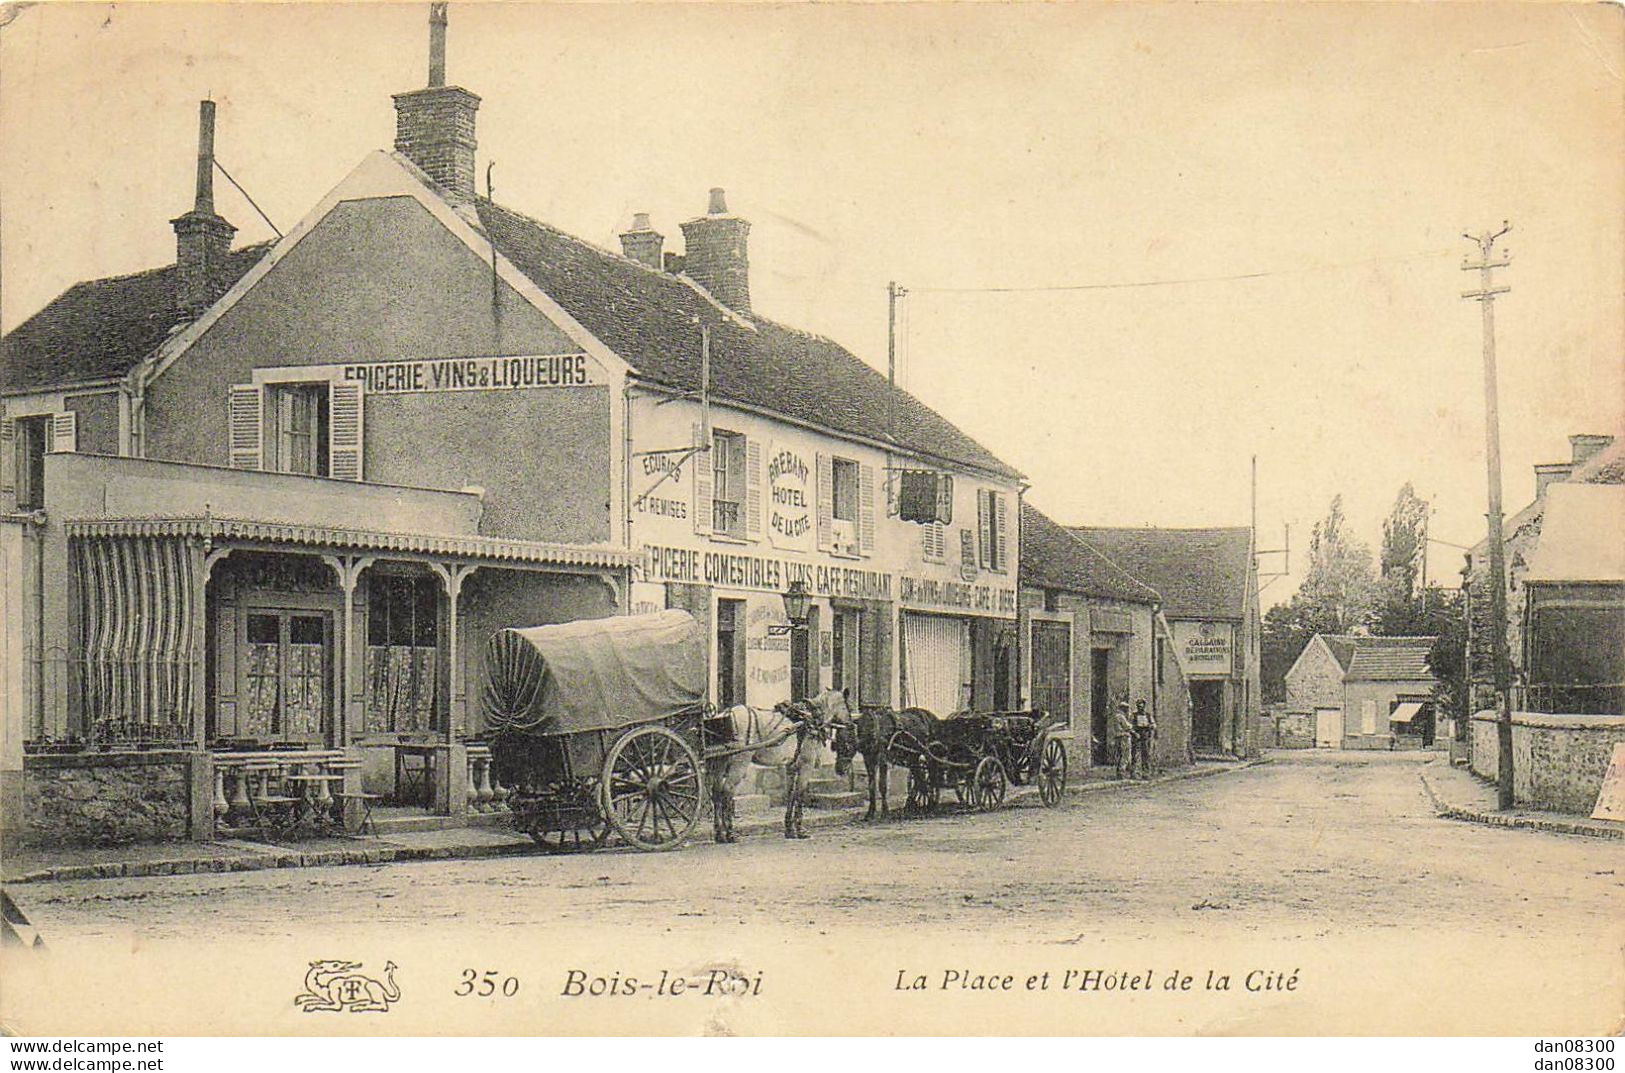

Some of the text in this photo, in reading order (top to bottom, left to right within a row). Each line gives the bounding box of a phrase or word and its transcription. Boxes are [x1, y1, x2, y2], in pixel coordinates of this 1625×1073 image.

[431, 361, 477, 388] VINS
[492, 355, 593, 389] LIQUEURS.
[651, 498, 687, 519] REMISES
[772, 486, 808, 508] HOTEL
[704, 552, 780, 589] COMESTIBLES
[843, 568, 892, 600] RESTAURANT
